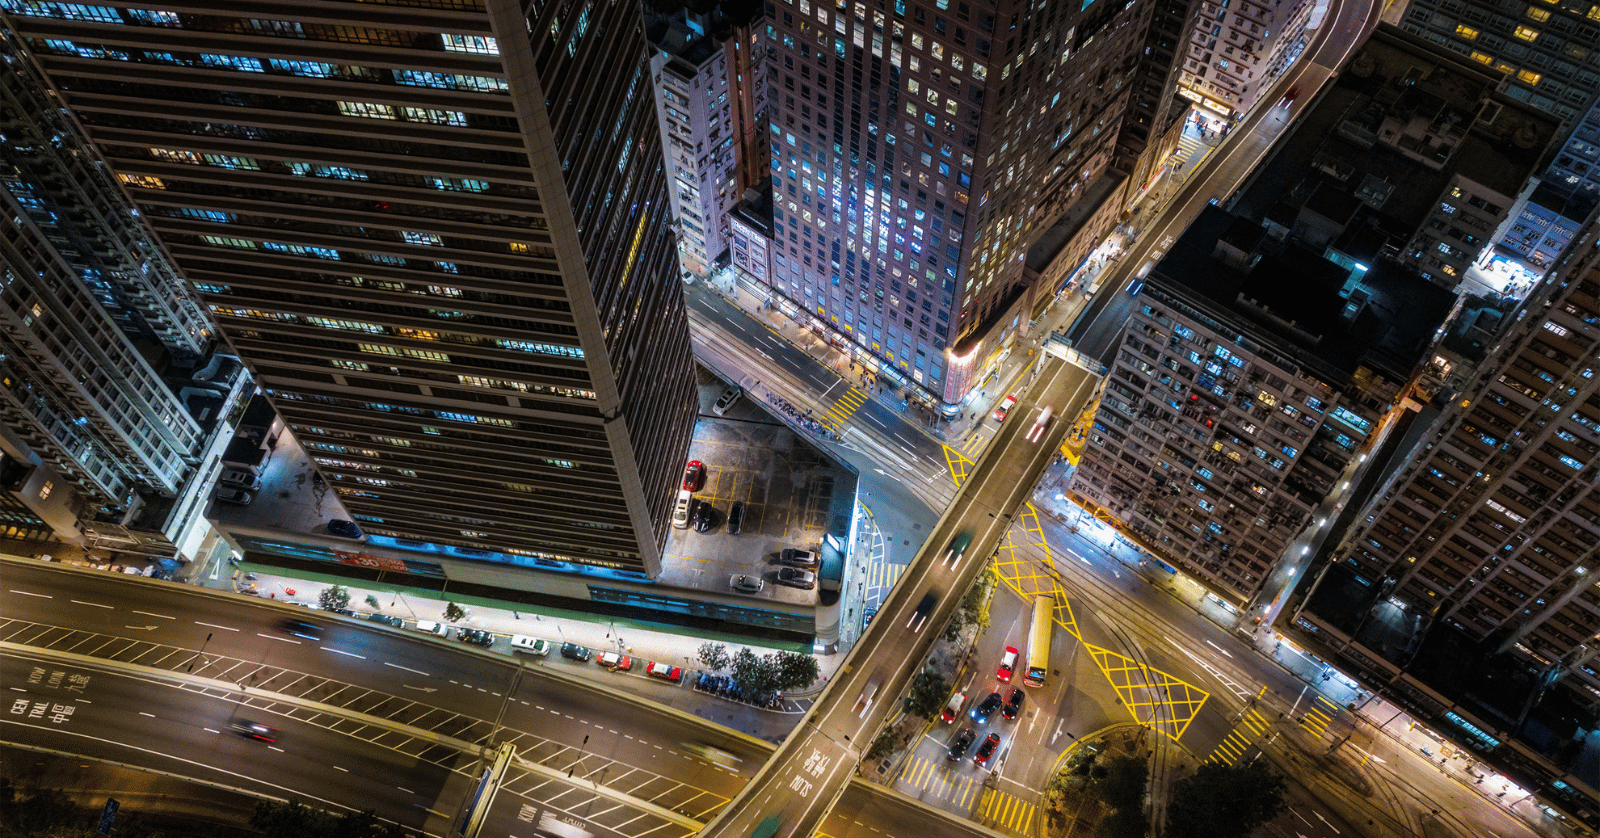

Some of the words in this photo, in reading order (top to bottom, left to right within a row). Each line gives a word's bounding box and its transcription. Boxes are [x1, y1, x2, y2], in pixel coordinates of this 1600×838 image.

[27, 666, 46, 684] KOW
[46, 670, 66, 689] LOON
[64, 673, 91, 694] 九龍
[10, 698, 30, 715] CEN
[28, 701, 50, 719] TRAL
[48, 703, 76, 724] 中區
[789, 774, 813, 798] SLOW
